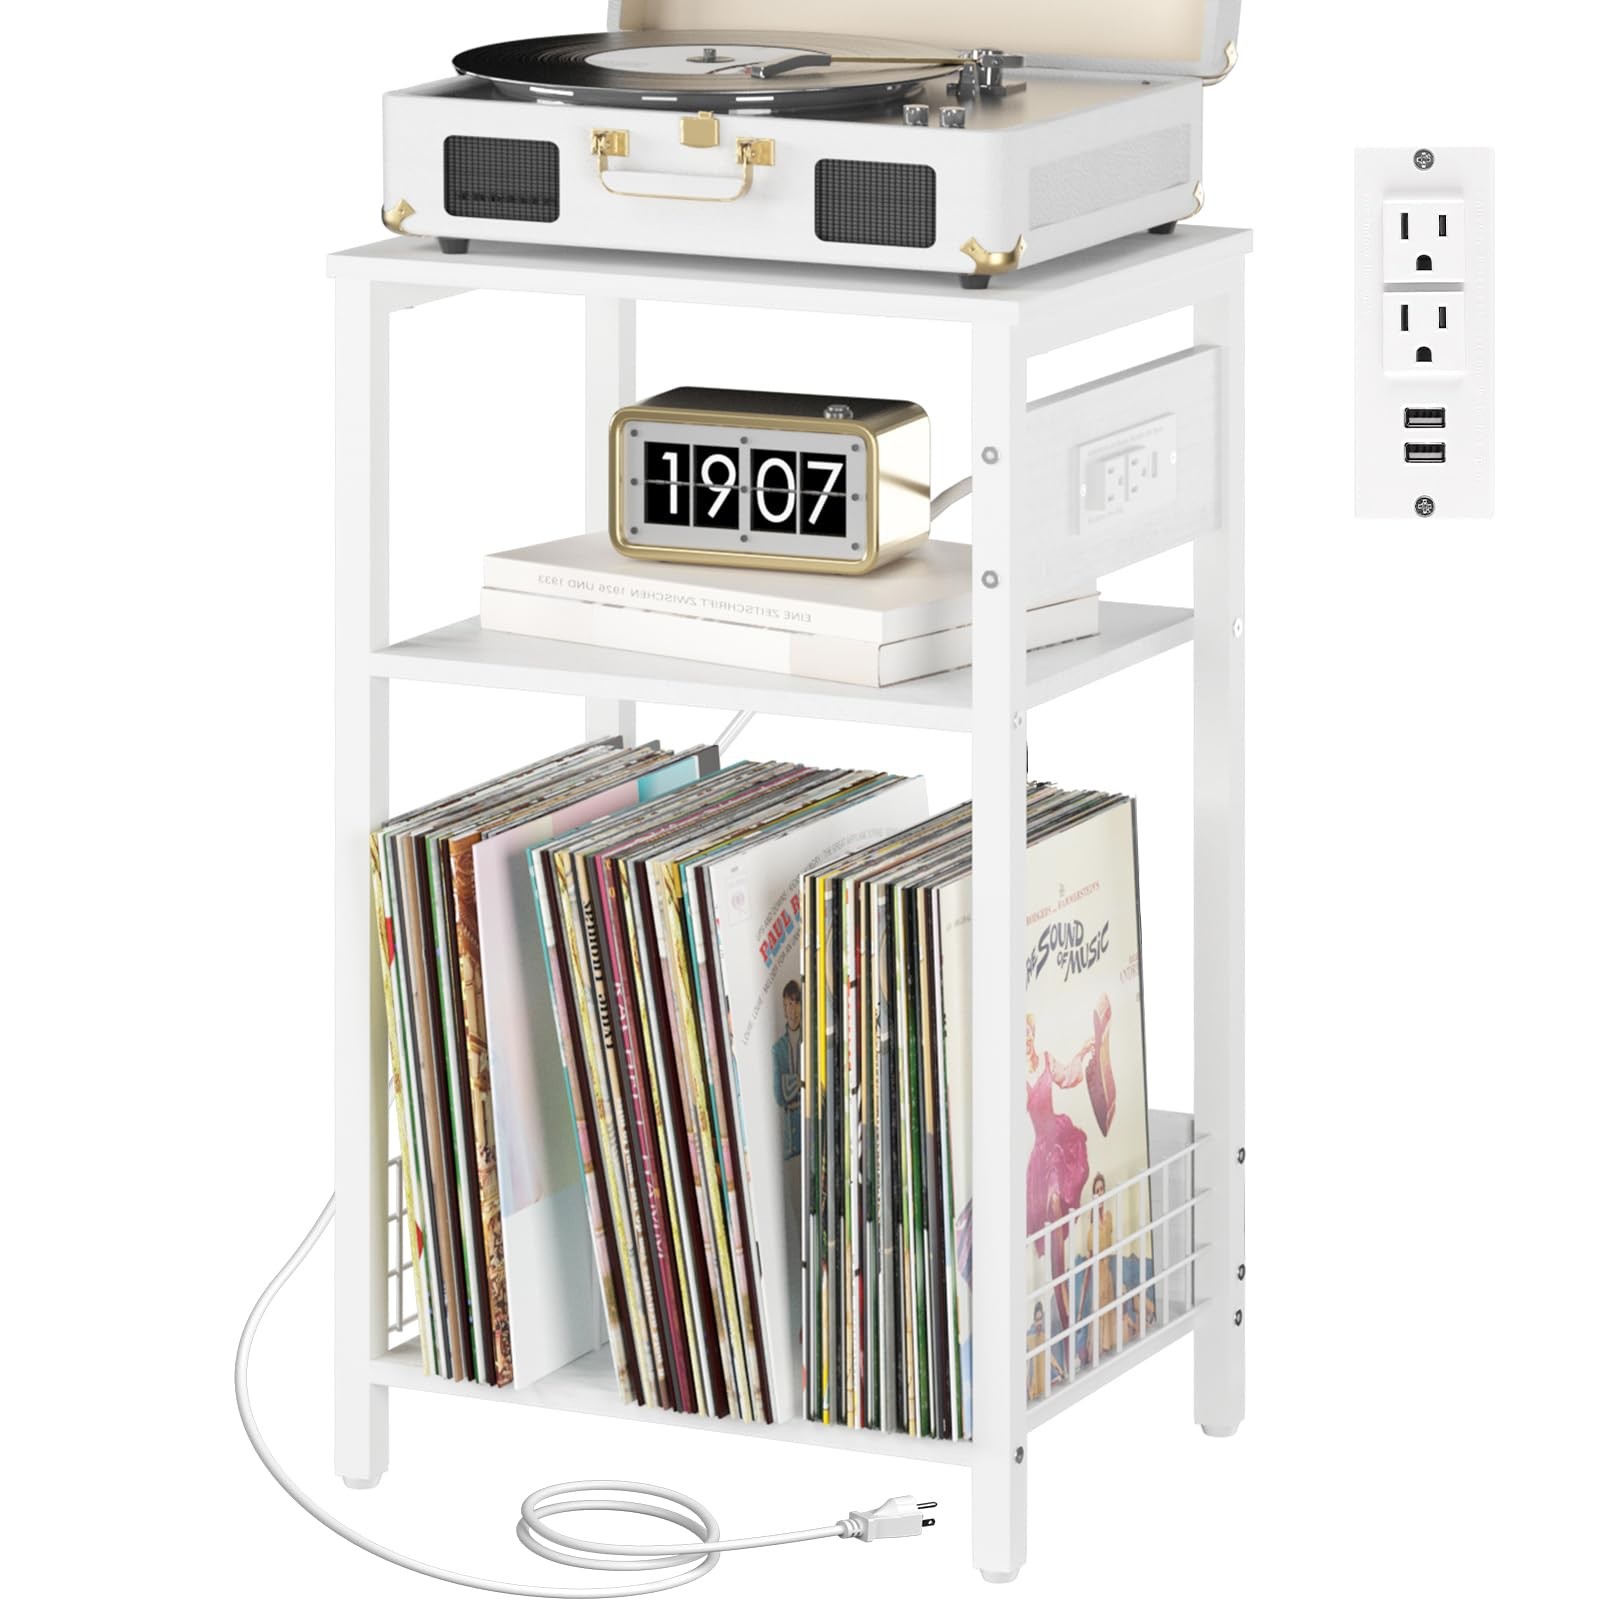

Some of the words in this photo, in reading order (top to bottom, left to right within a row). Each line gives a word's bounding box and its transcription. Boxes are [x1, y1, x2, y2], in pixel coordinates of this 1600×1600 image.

[662, 451, 844, 526] 1907
[760, 909, 793, 966] PAUL
[1035, 919, 1084, 980] SOUND
